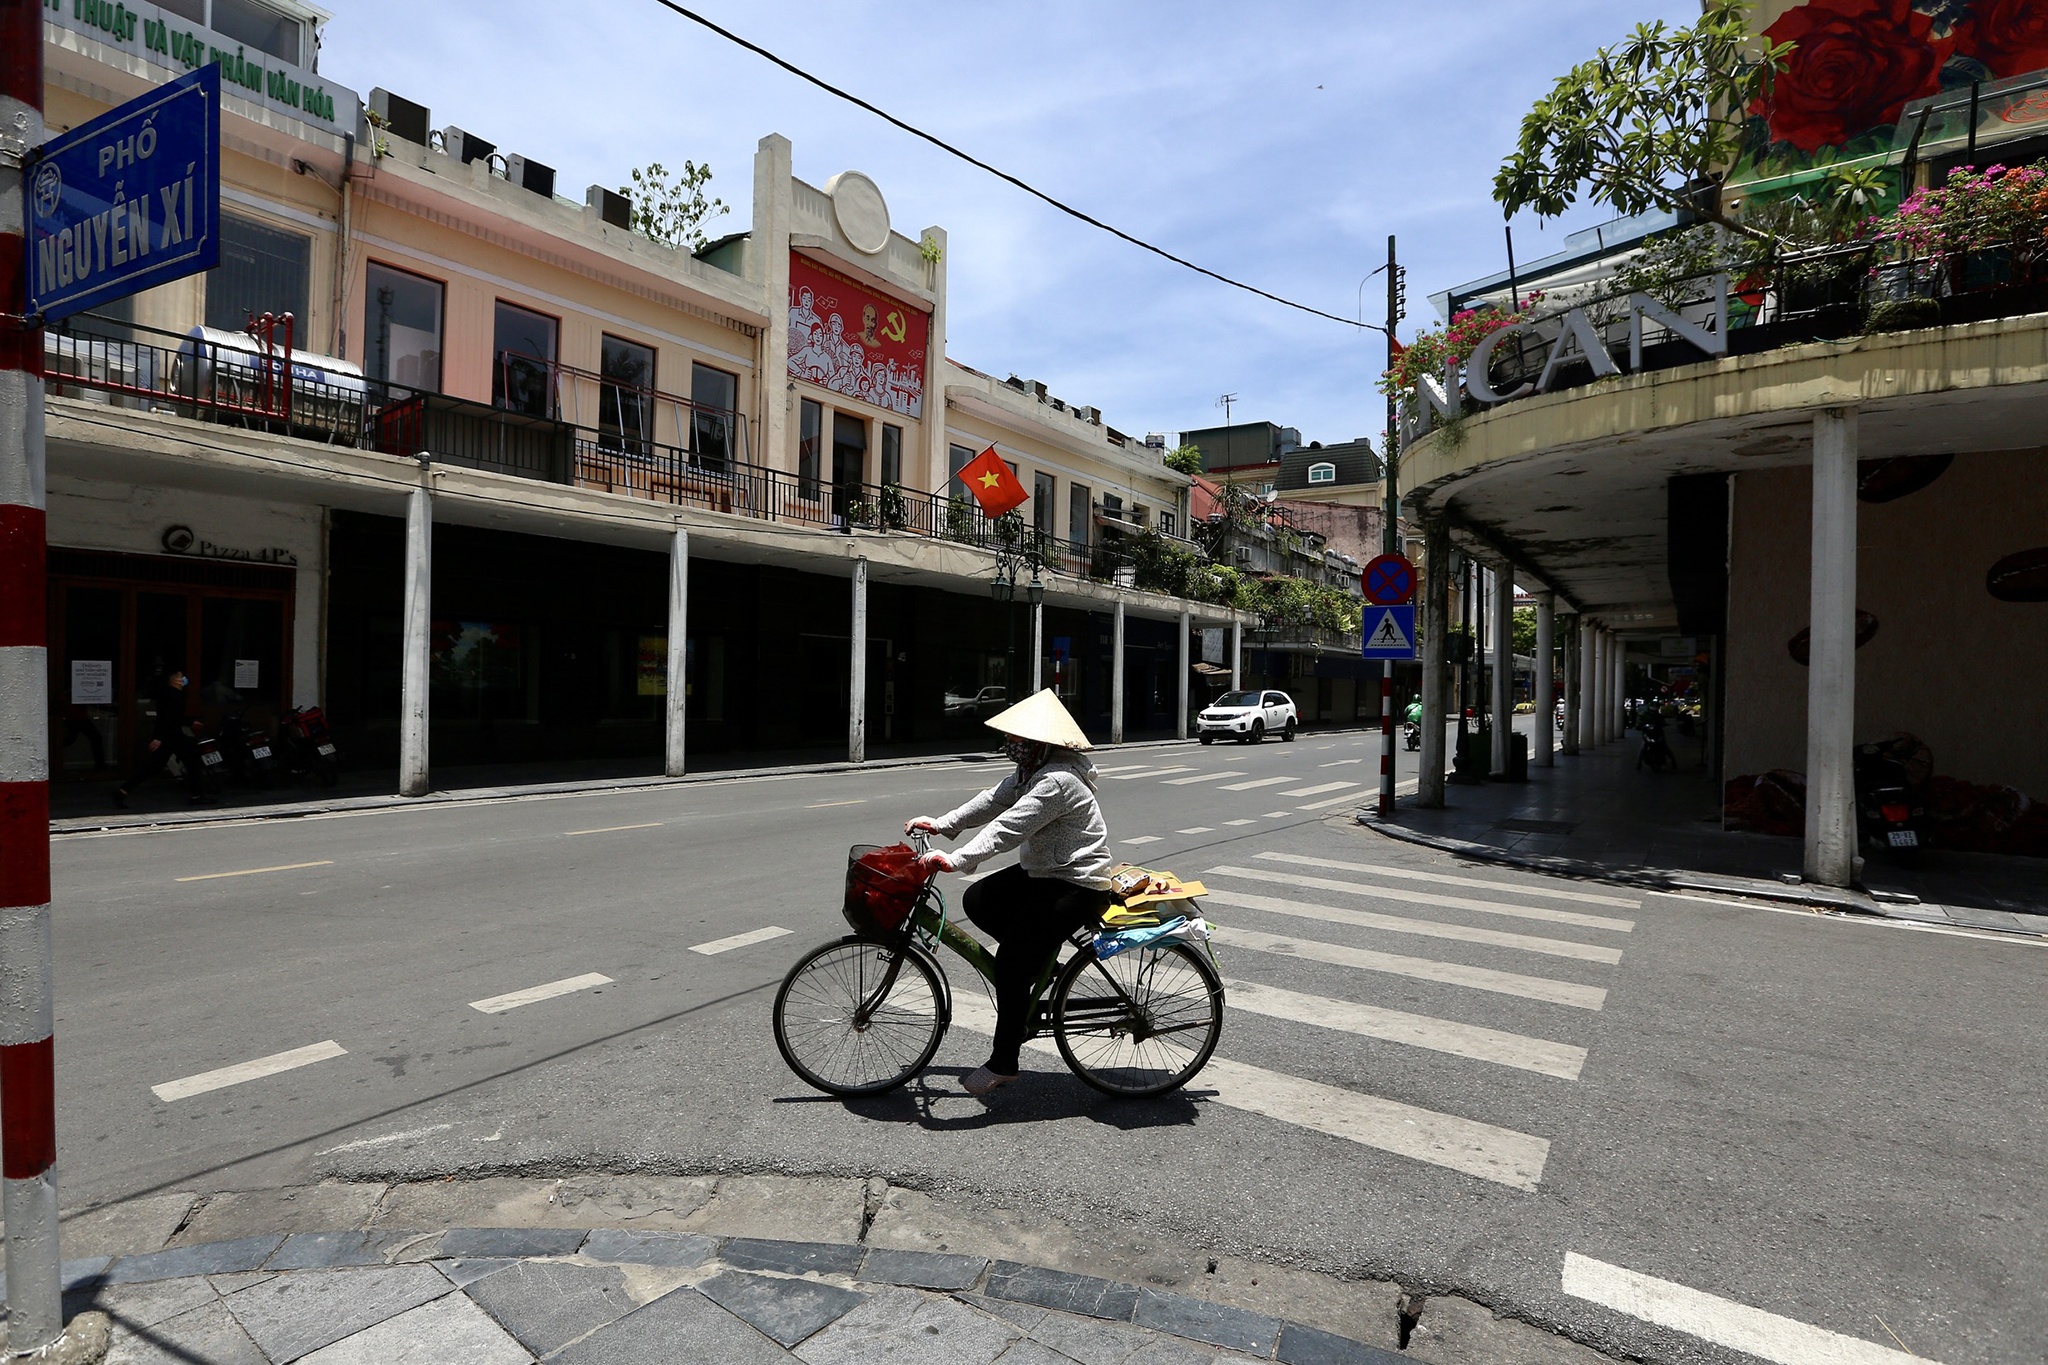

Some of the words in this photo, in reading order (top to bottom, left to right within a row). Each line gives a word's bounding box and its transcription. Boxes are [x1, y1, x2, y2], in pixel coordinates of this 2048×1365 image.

[144, 18, 168, 55] VÀ
[171, 31, 205, 70] VẬT
[267, 69, 300, 108] VĂN
[303, 85, 335, 122] HÓA
[99, 109, 160, 177] PHỐ
[39, 180, 150, 295] NGUYỄN
[160, 161, 196, 249] XÍ
[201, 541, 250, 560] Pizza
